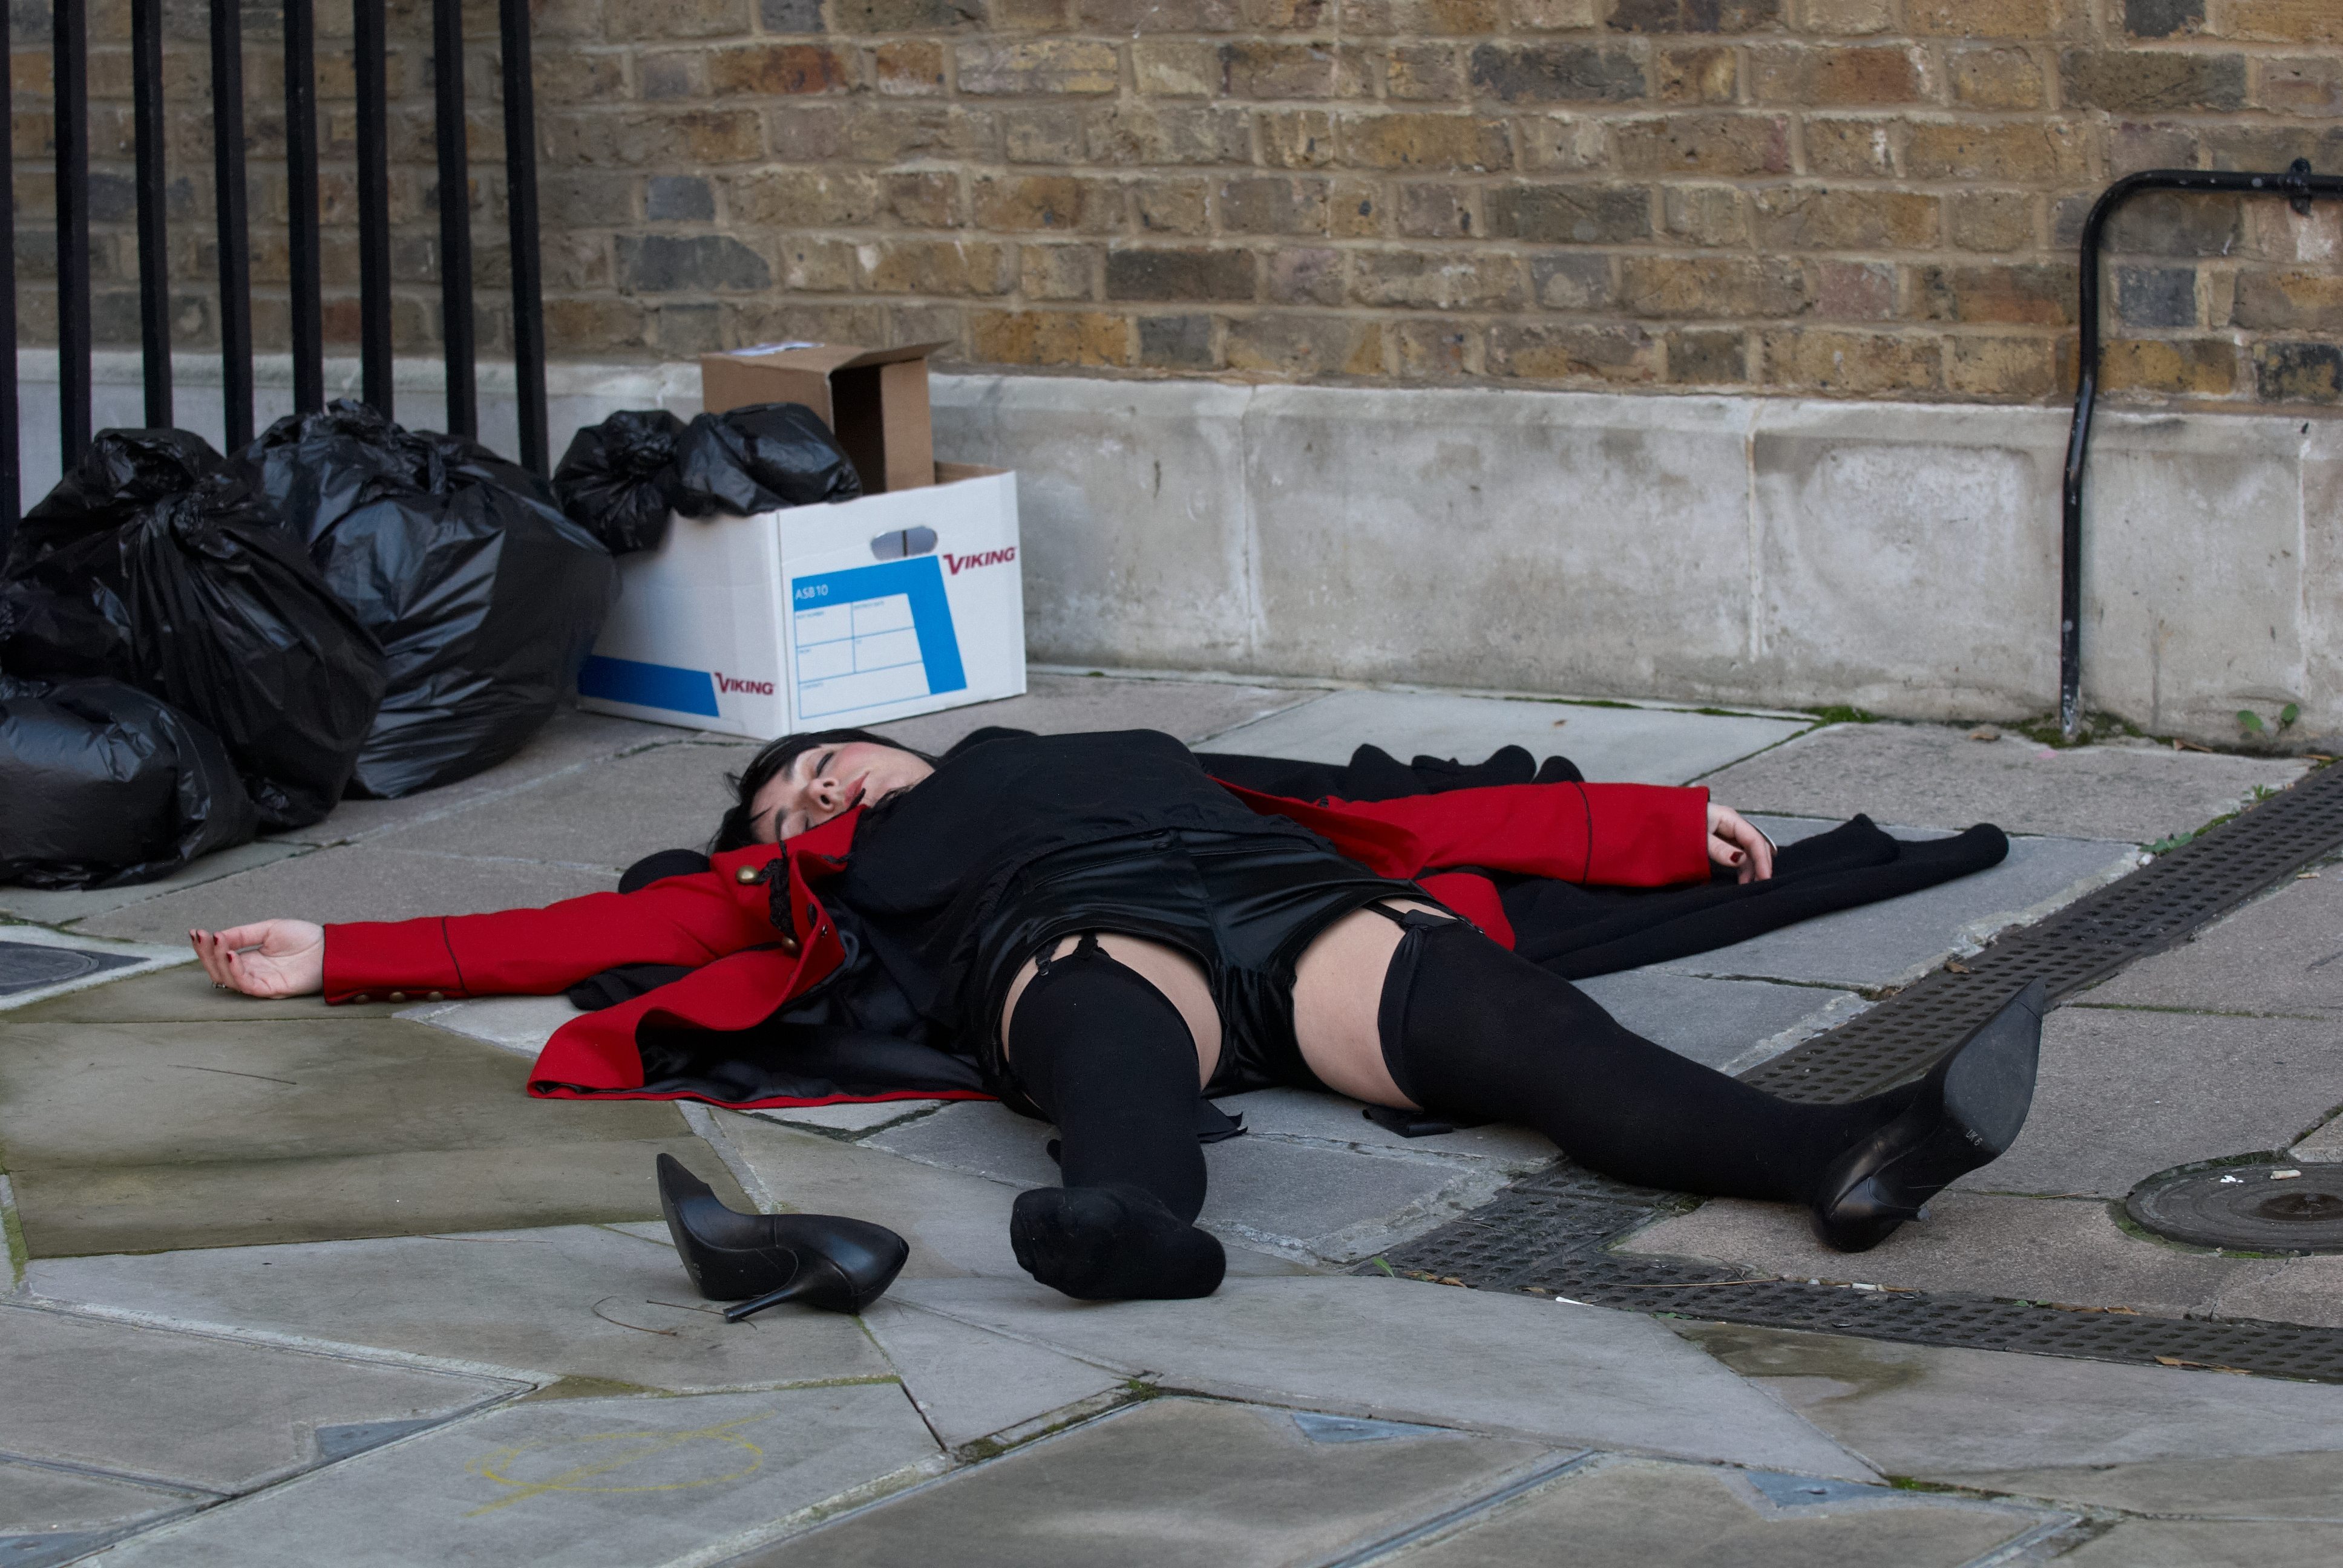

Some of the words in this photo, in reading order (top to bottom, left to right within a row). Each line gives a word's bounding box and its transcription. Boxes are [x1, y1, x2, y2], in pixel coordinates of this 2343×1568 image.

[943, 546, 1016, 575] VIKING
[795, 587, 815, 600] ASB
[816, 584, 828, 596] 10
[714, 672, 774, 695] VIKING
